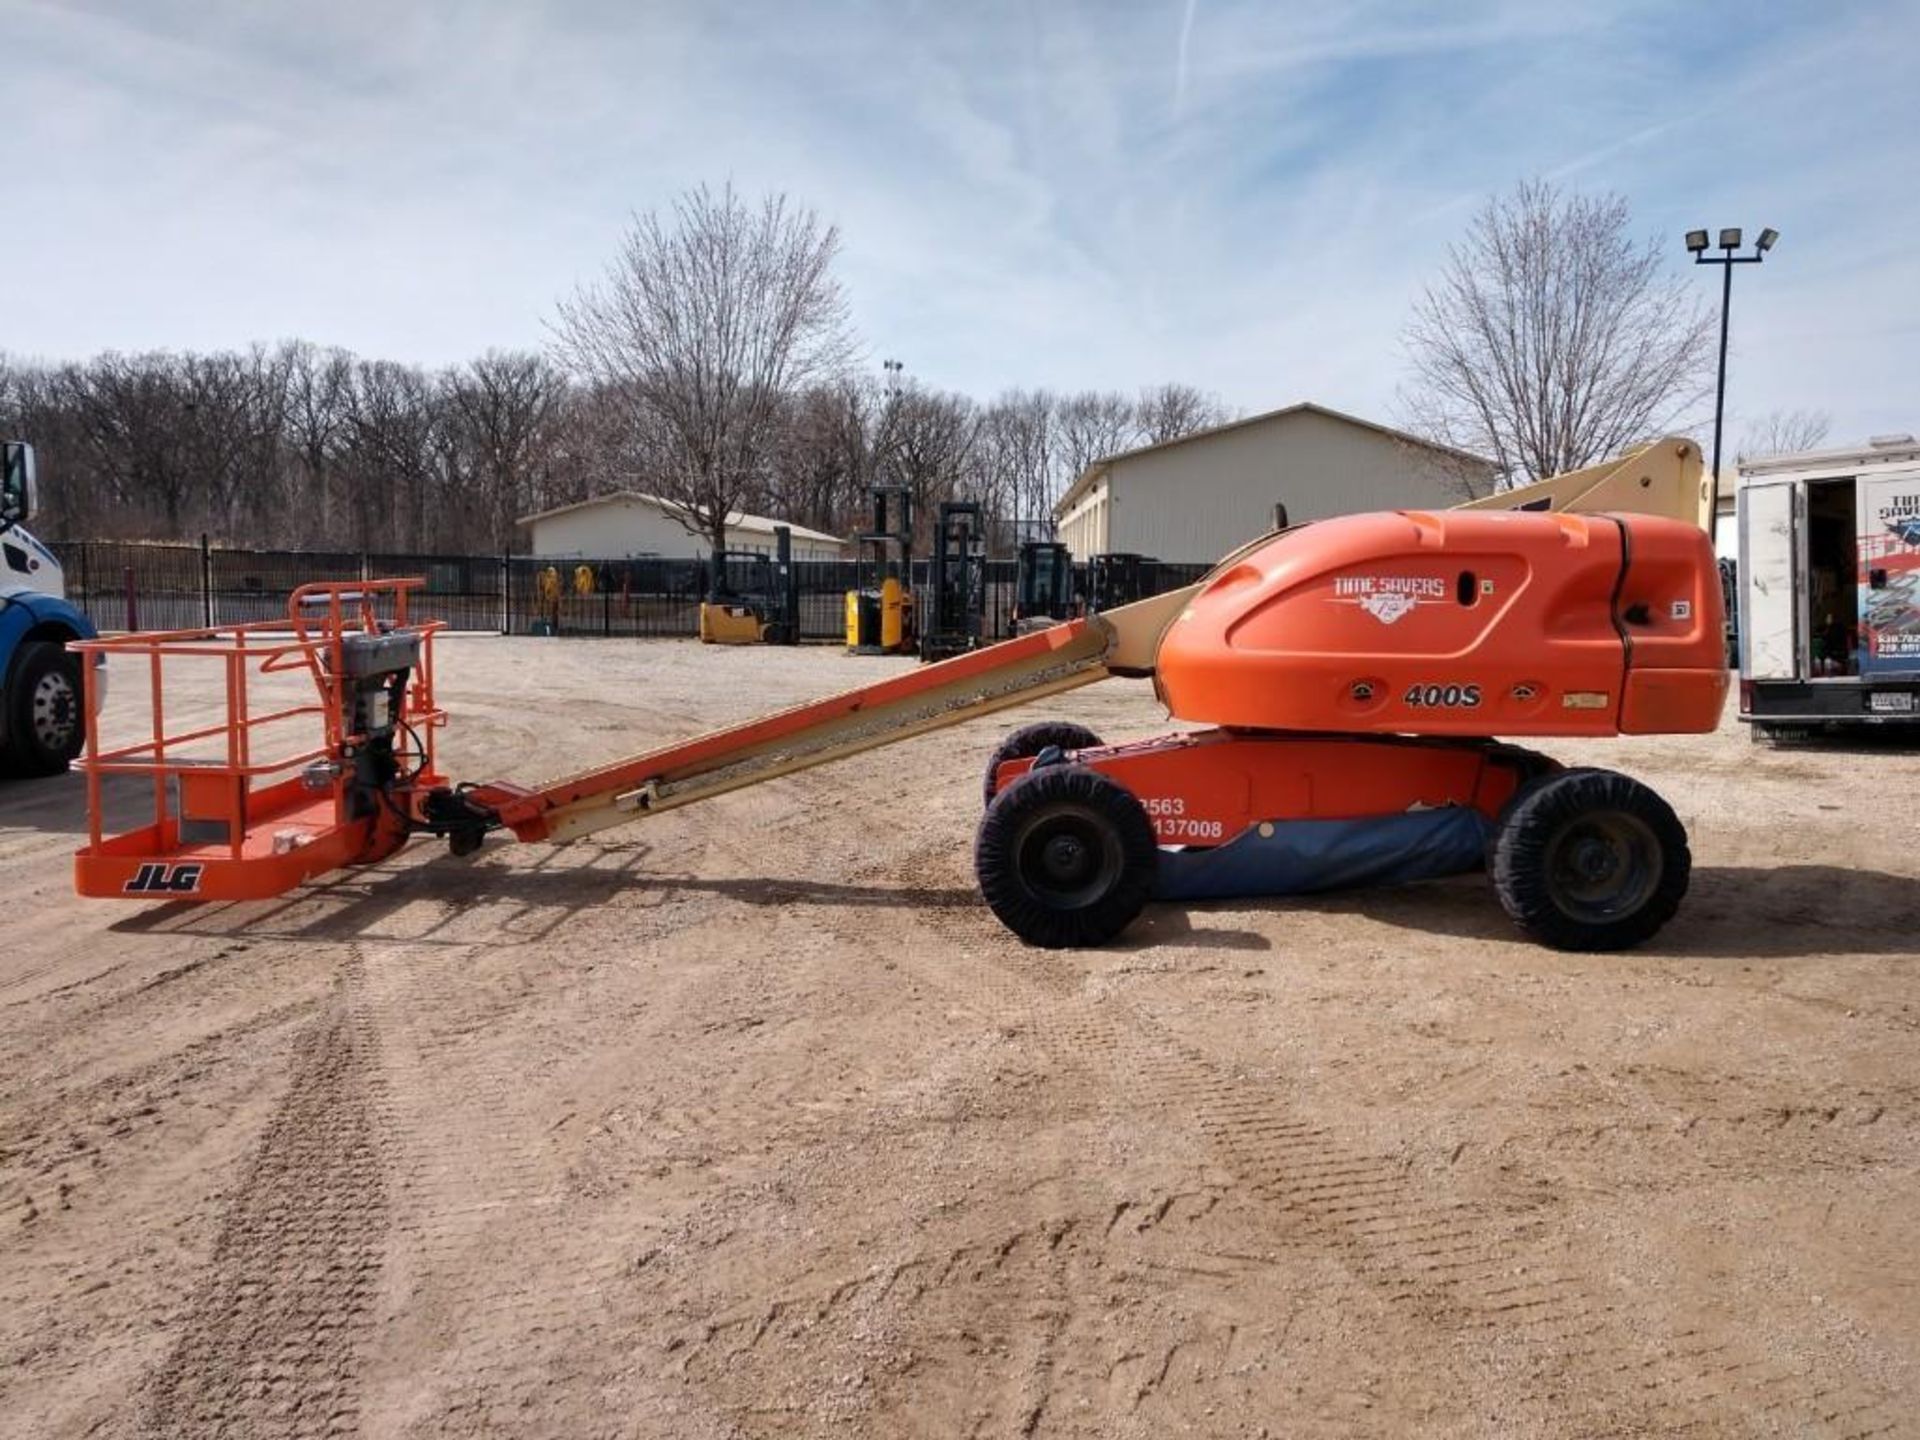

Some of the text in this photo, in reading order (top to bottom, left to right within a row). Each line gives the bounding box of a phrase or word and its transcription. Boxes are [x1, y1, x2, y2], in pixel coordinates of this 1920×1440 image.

[1334, 577, 1445, 597] TIME SAVERS
[1403, 684, 1481, 707] 400S
[1153, 820, 1223, 838] 137008
[123, 863, 204, 892] JLG
